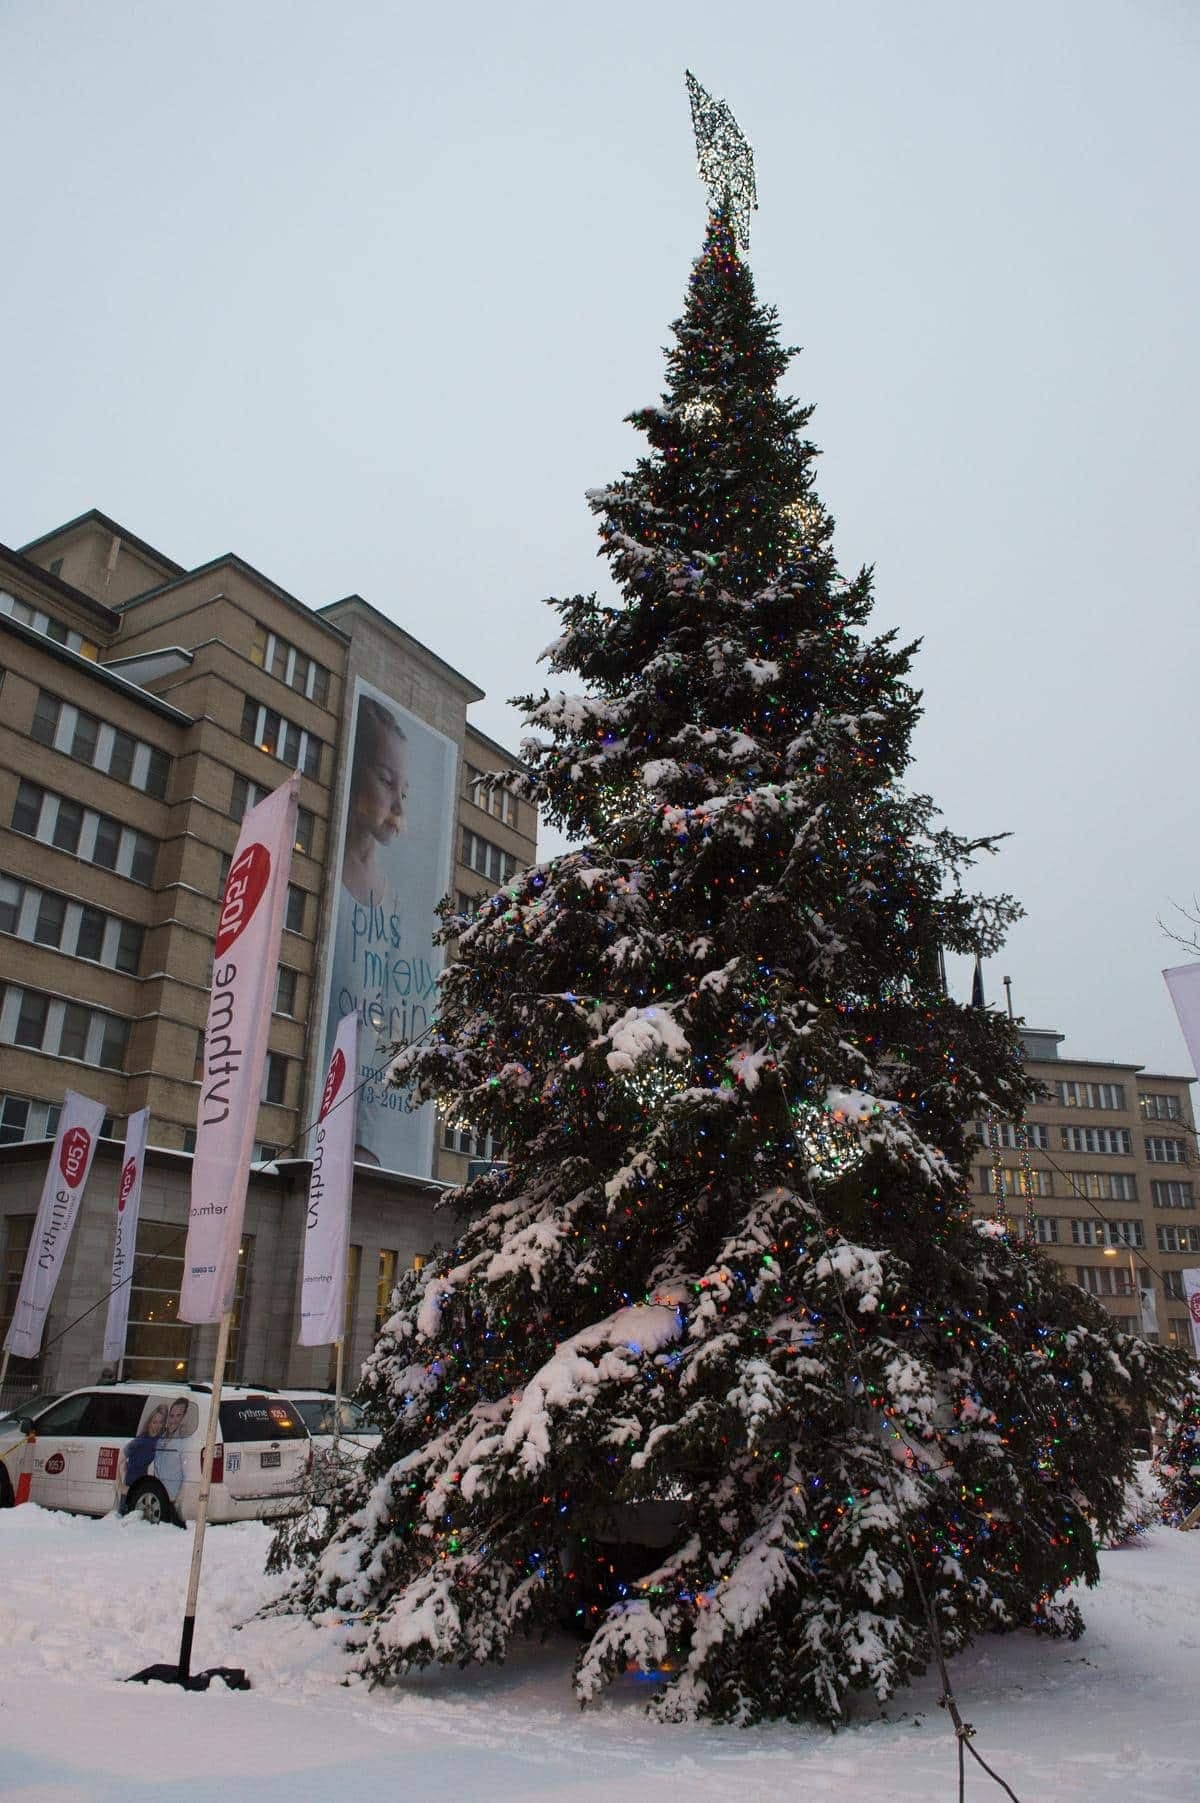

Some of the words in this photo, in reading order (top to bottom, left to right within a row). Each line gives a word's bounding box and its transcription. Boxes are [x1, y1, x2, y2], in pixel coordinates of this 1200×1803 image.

[351, 889, 402, 963] plus
[363, 949, 437, 1000] mieux
[64, 1130, 89, 1178] 105.7
[37, 1189, 71, 1270] rythme
[238, 1407, 268, 1421] rythme
